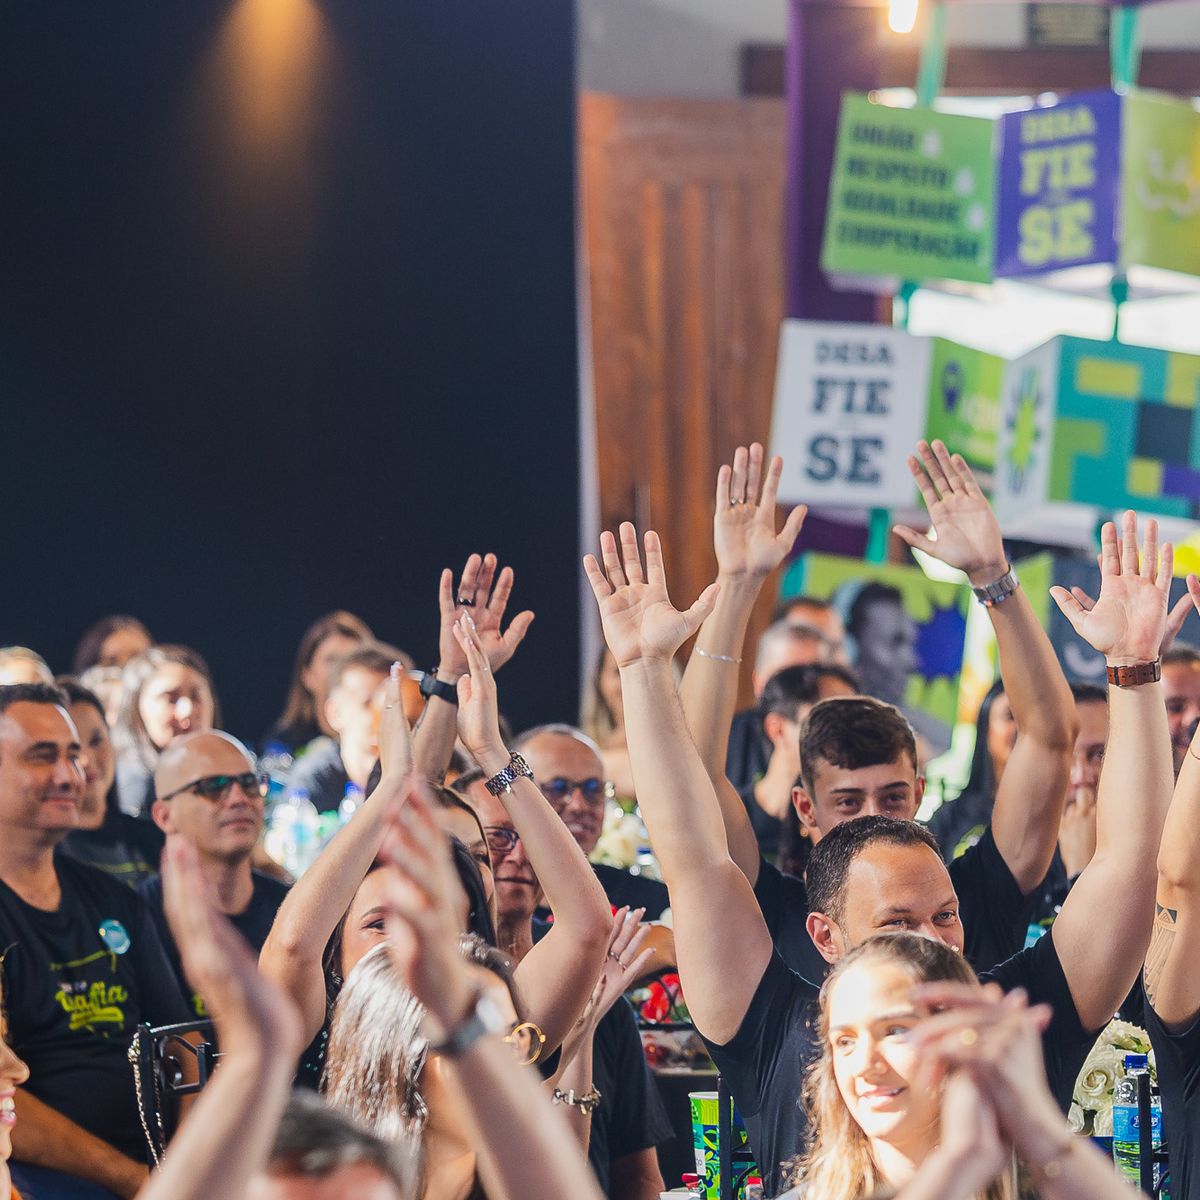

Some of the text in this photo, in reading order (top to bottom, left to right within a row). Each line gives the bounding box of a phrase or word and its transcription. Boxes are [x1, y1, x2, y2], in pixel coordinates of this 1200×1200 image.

[1020, 144, 1095, 196] FIE
[1018, 200, 1094, 266] SE
[812, 377, 891, 414] FIE
[805, 433, 884, 484] SE
